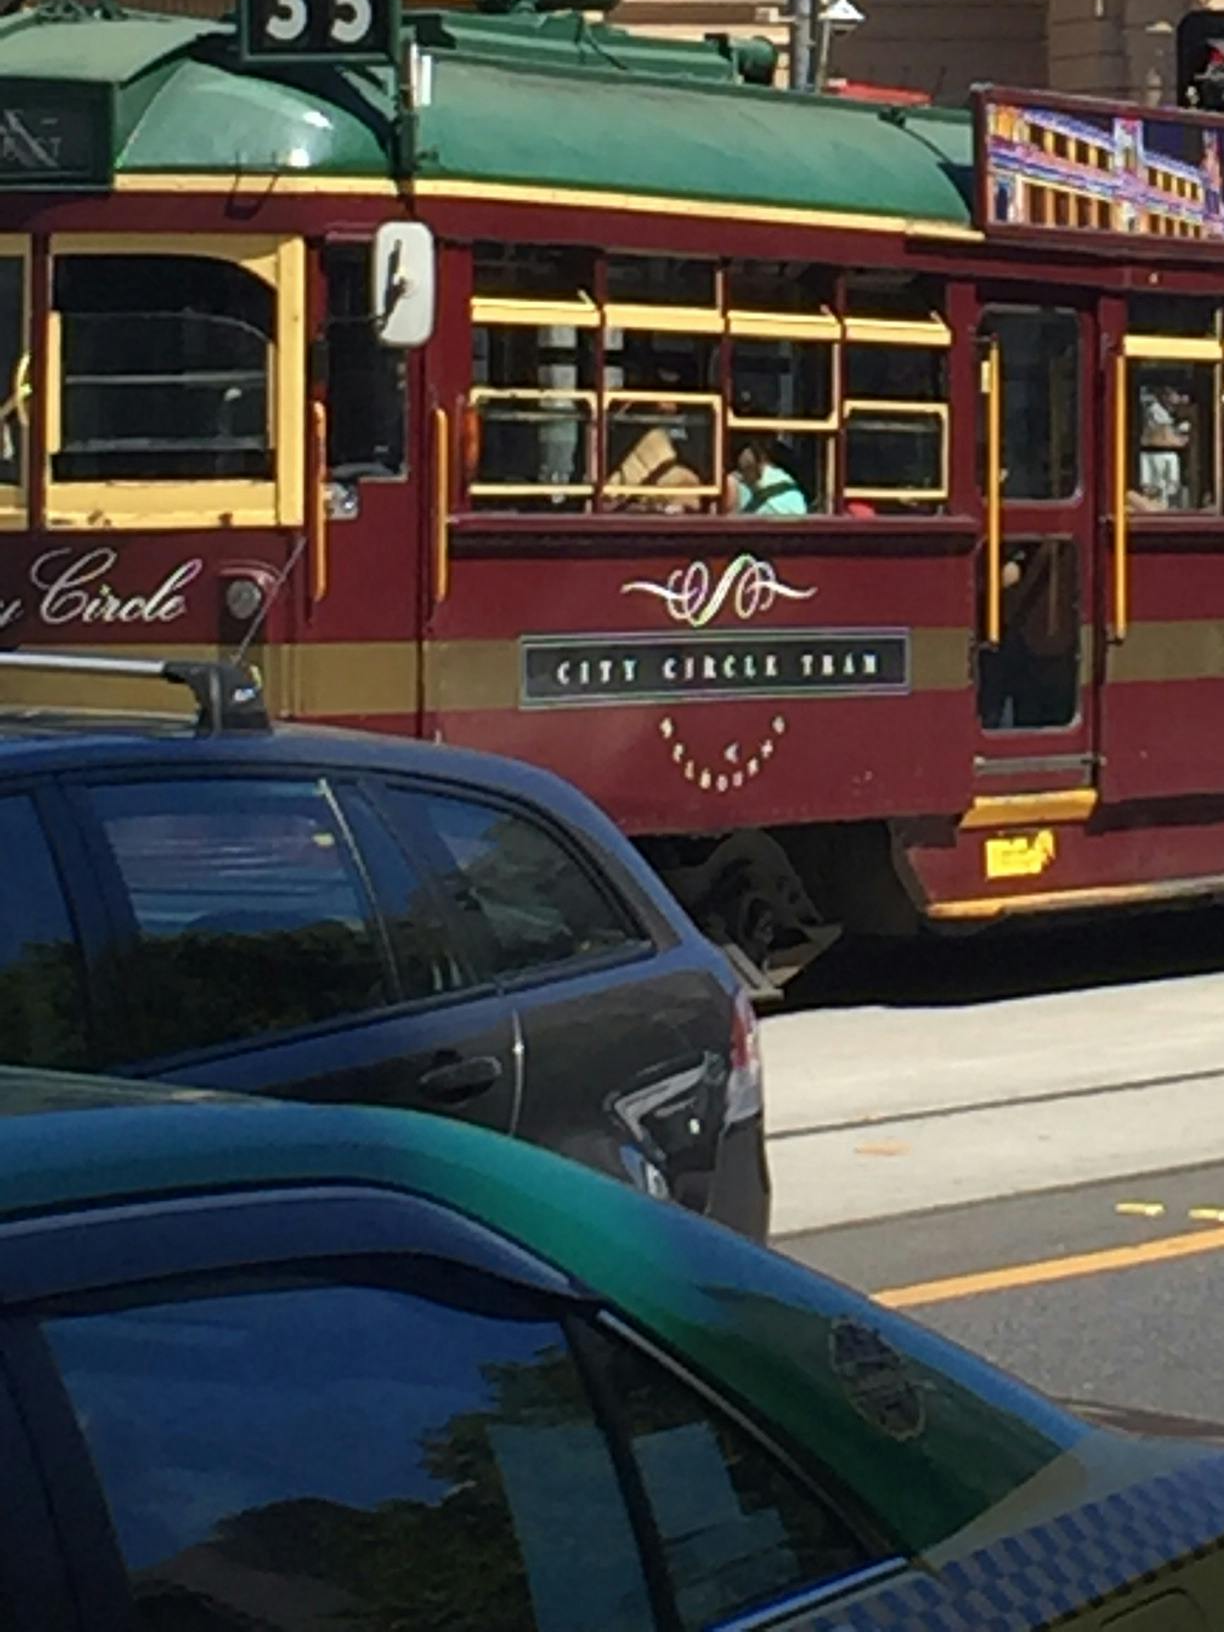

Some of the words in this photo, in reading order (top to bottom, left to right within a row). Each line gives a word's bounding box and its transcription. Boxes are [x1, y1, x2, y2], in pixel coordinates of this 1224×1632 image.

[30, 546, 203, 625] Circle
[556, 659, 638, 685] CITY
[661, 654, 779, 679] CIRCLE
[801, 652, 881, 676] TRAM
